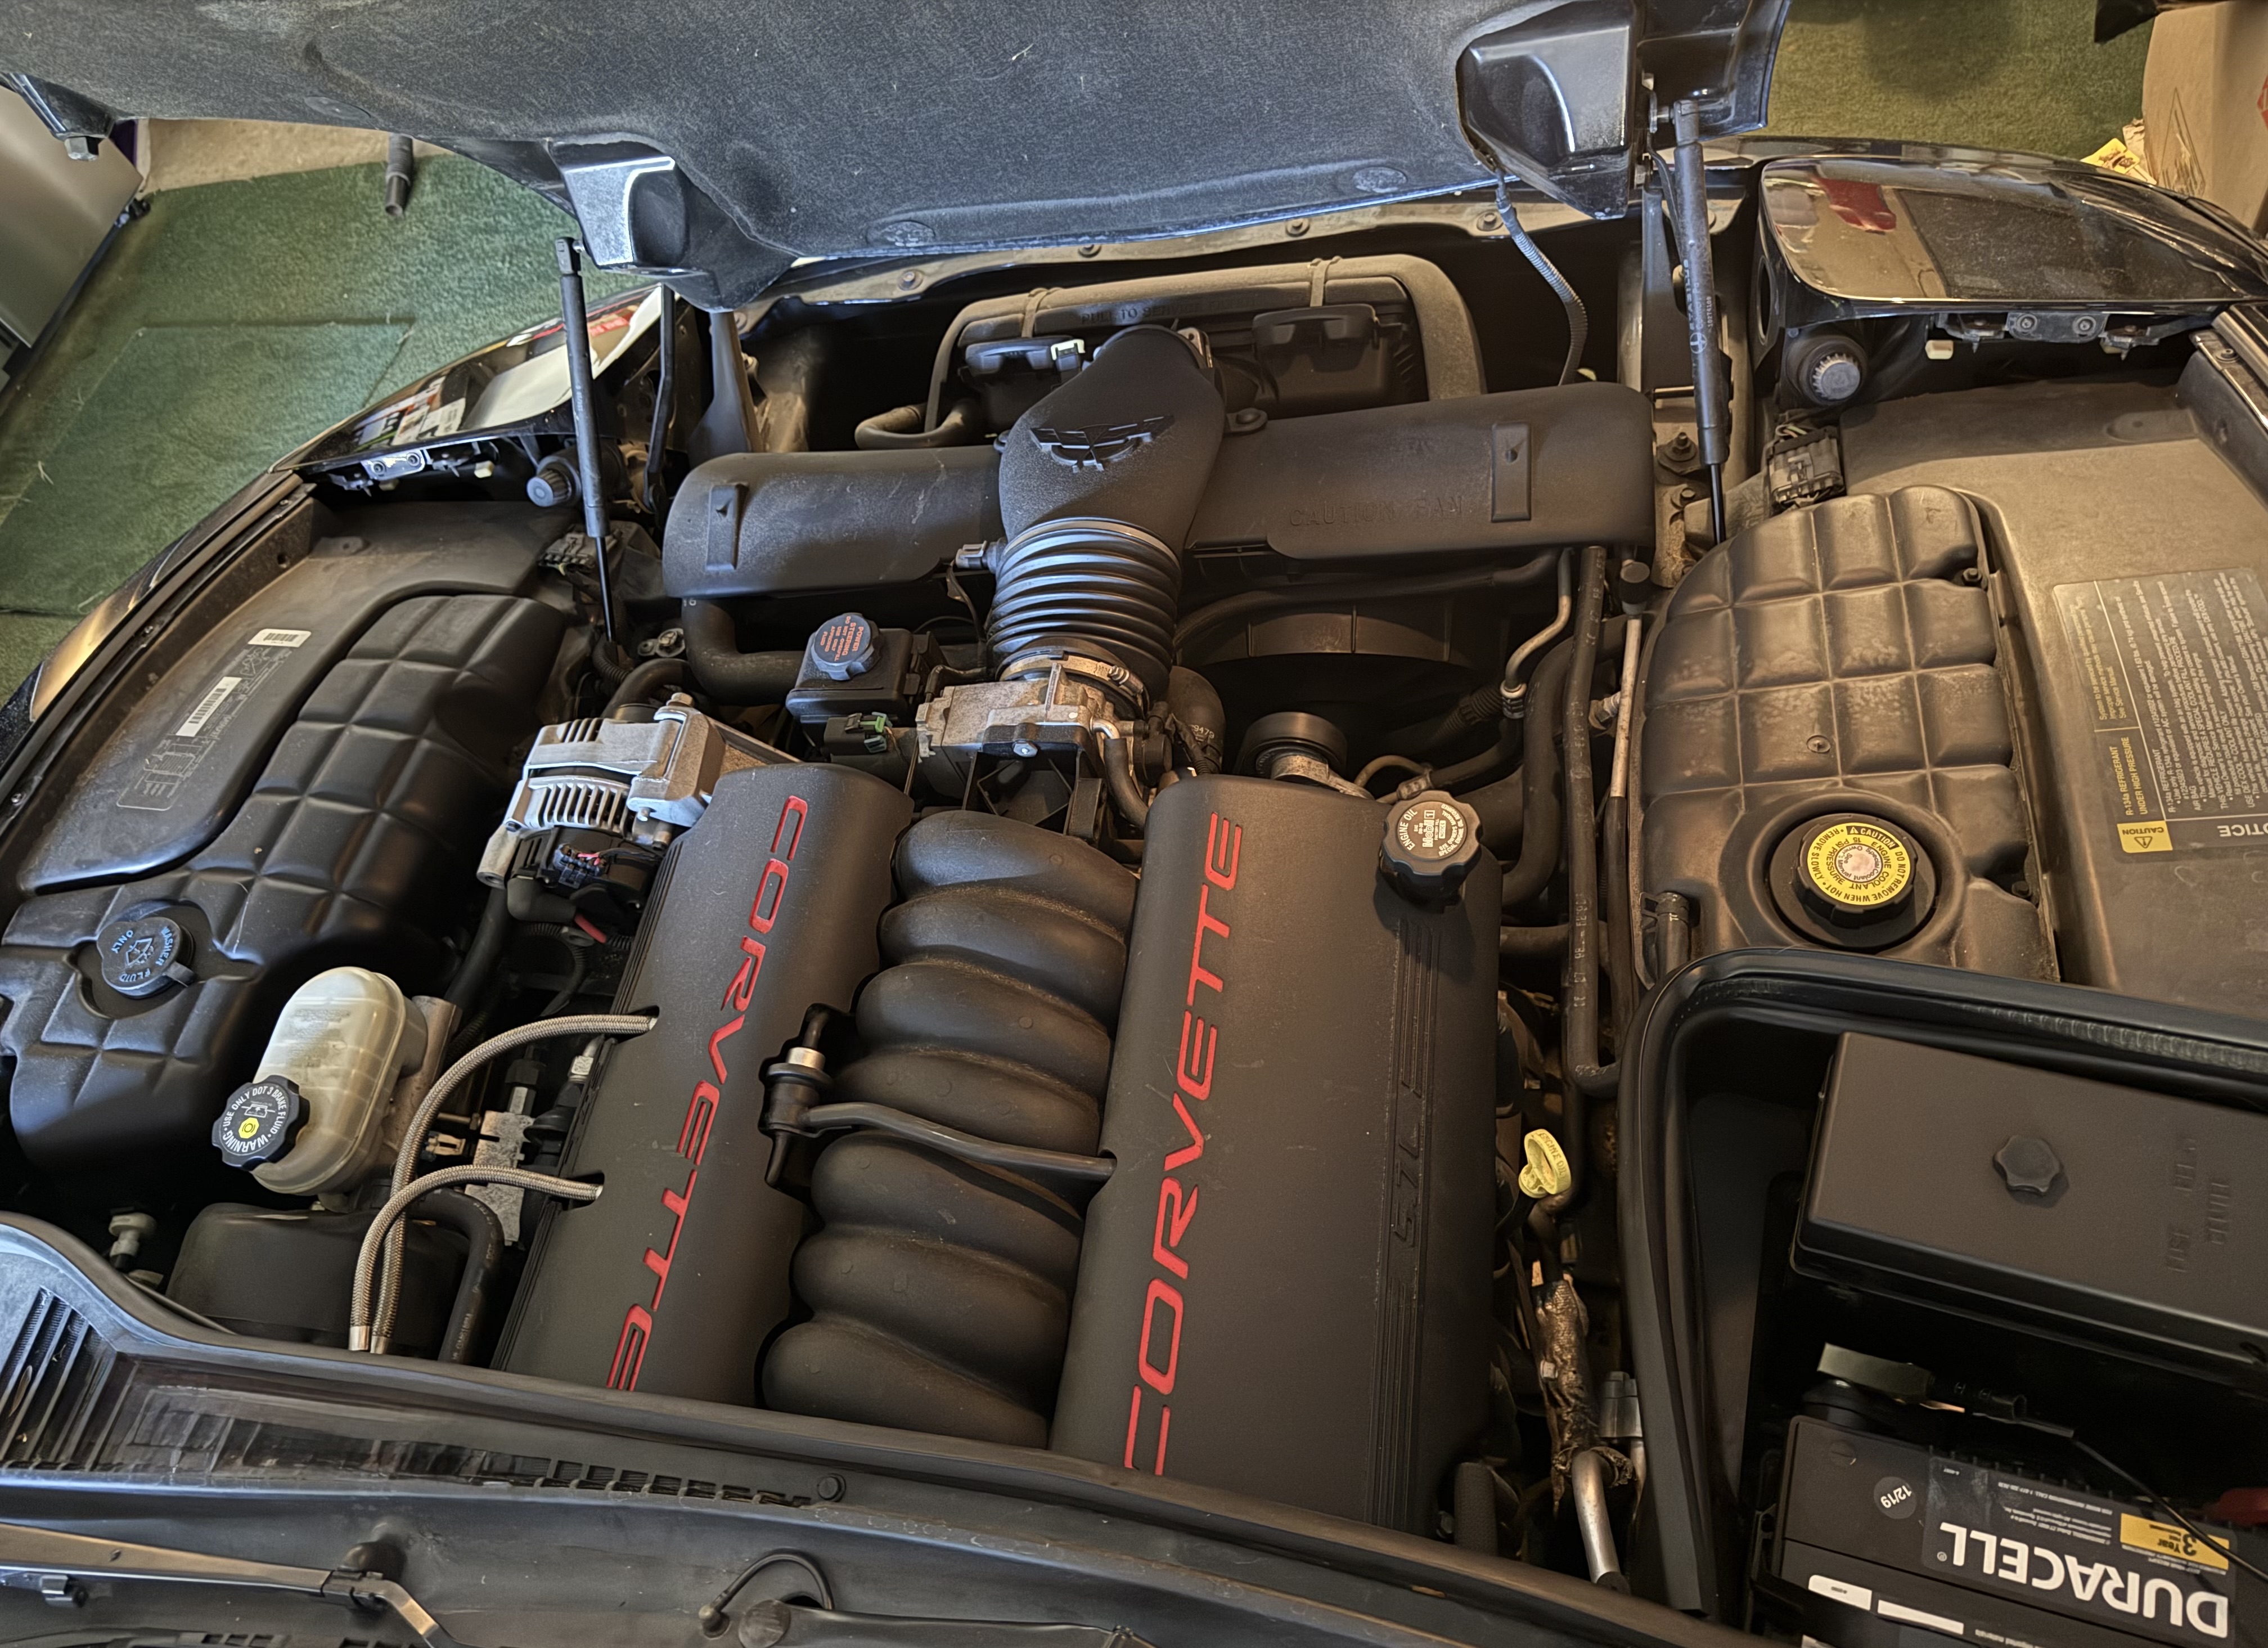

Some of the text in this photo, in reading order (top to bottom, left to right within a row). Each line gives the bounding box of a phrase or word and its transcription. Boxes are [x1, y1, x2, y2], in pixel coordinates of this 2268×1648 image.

[1289, 500, 1396, 527] CAUTION
[842, 622, 856, 655] STEERING
[852, 626, 864, 652] POWER
[2179, 668, 2189, 679] FILL
[2182, 680, 2198, 706] COOLANT
[2191, 706, 2205, 730] SPECIAL
[2200, 735, 2216, 766] REQUIRES
[2218, 710, 2255, 807] USE COOLANT ONLY
[2109, 746, 2134, 815] R-134a REFRIGERANT
[2121, 737, 2148, 814] UNDER HIGH PRESSURE
[2152, 748, 2176, 812] R-134a REFRIGERANT
[2209, 767, 2224, 793] VEHICLE
[2188, 785, 2202, 810] AIR BAG
[2217, 794, 2229, 809] THIS
[1399, 809, 1418, 851] ENGINE OIL
[1422, 819, 1434, 847] Mobil
[1837, 838, 1850, 849] PSI
[2122, 827, 2164, 835] CAUTION
[1811, 828, 1840, 881] REMOVE SLOWLY
[1825, 828, 1906, 902] CAUTION DO NOT REMOVE WHEN HOT
[1826, 846, 1846, 885] PRESSURE
[1843, 852, 1853, 864] See
[1848, 841, 1892, 890] ENGINE COOLANT
[1853, 847, 1880, 881] Special Coolant
[111, 929, 134, 954] ONLY
[119, 926, 173, 982] WASHER FLUID
[607, 797, 806, 1391] CORVETTE
[223, 1086, 287, 1135] USE ONLY DOT 3 BRAKE FLUID
[222, 1129, 269, 1152] WARNING
[1124, 812, 1241, 1475] CORVETTE
[1537, 1133, 1562, 1160] ENGINE
[1879, 1484, 1914, 1510] 12/19
[2157, 1538, 2181, 1554] Year
[2182, 1533, 2197, 1556] 3
[1939, 1521, 2230, 1639] DURACELL
